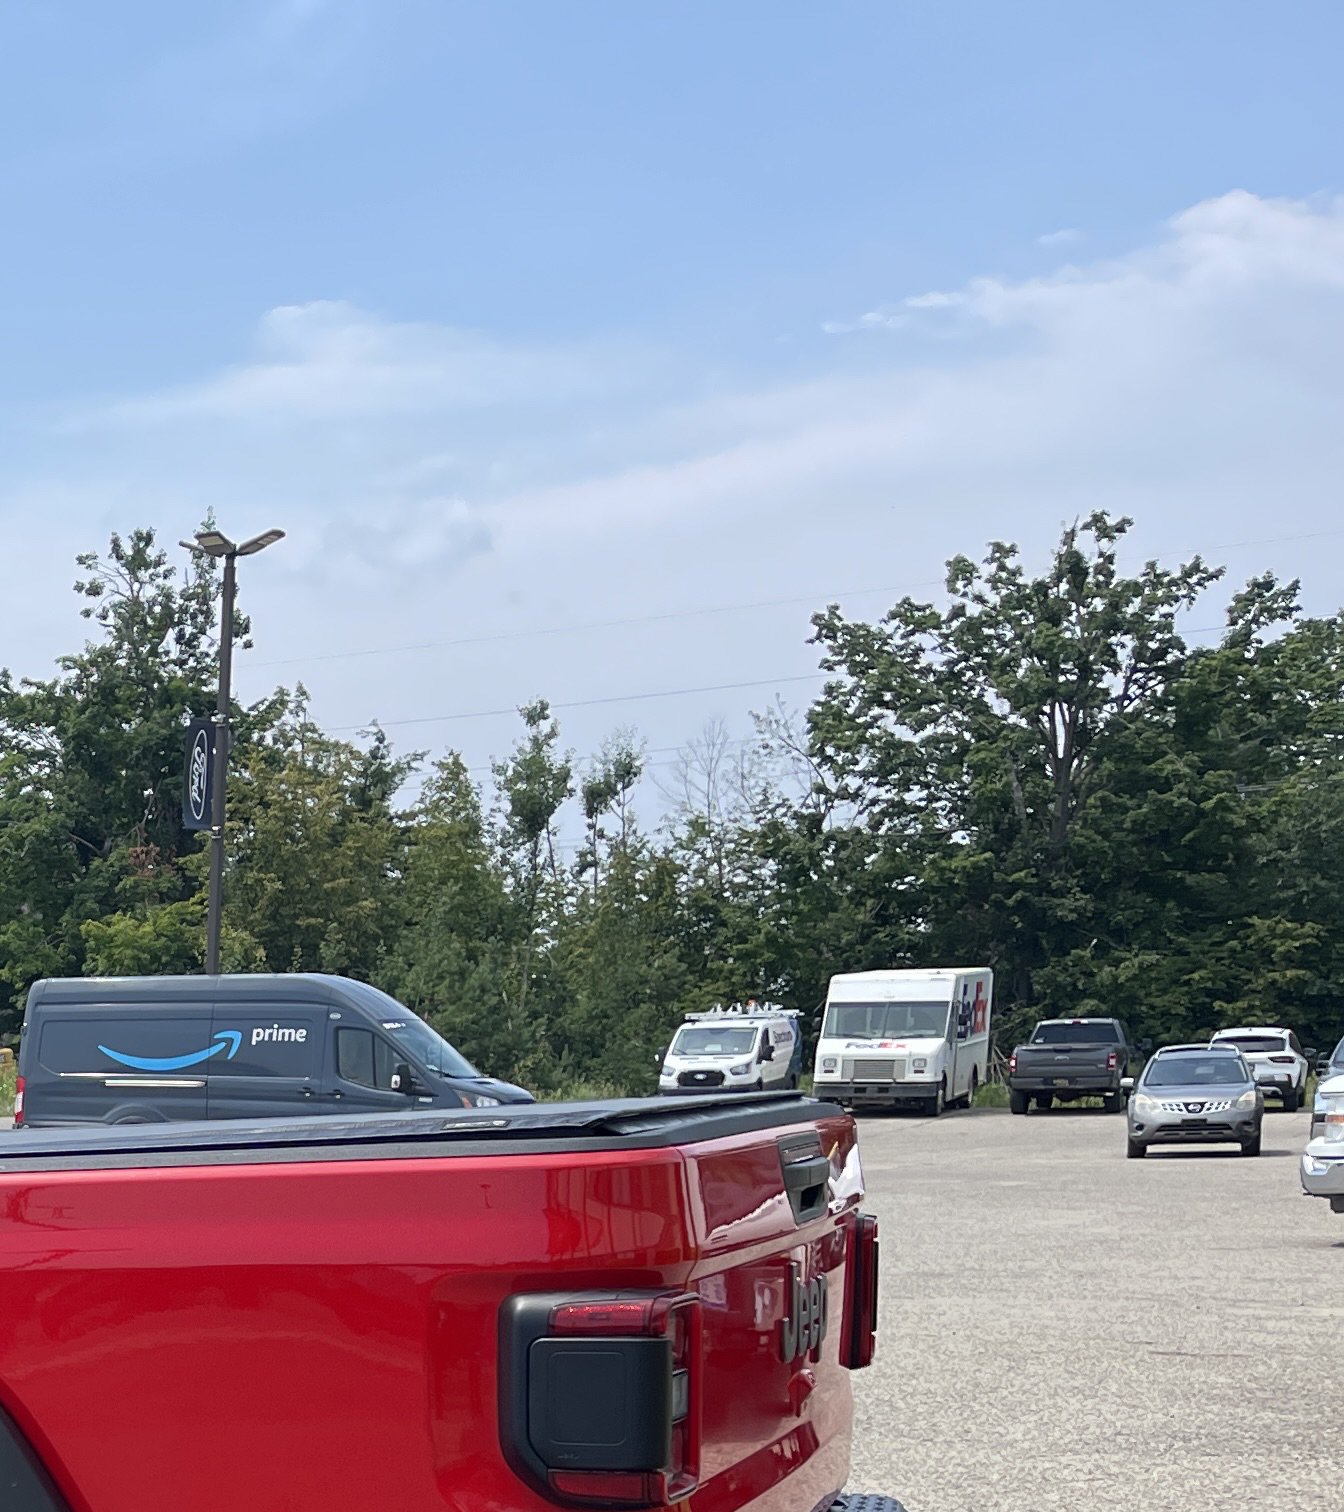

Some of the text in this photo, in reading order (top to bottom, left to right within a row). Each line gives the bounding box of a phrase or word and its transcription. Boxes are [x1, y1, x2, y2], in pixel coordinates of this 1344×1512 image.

[251, 1023, 307, 1046] prime
[845, 1042, 910, 1050] FedEx
[781, 1261, 829, 1364] Jeep
